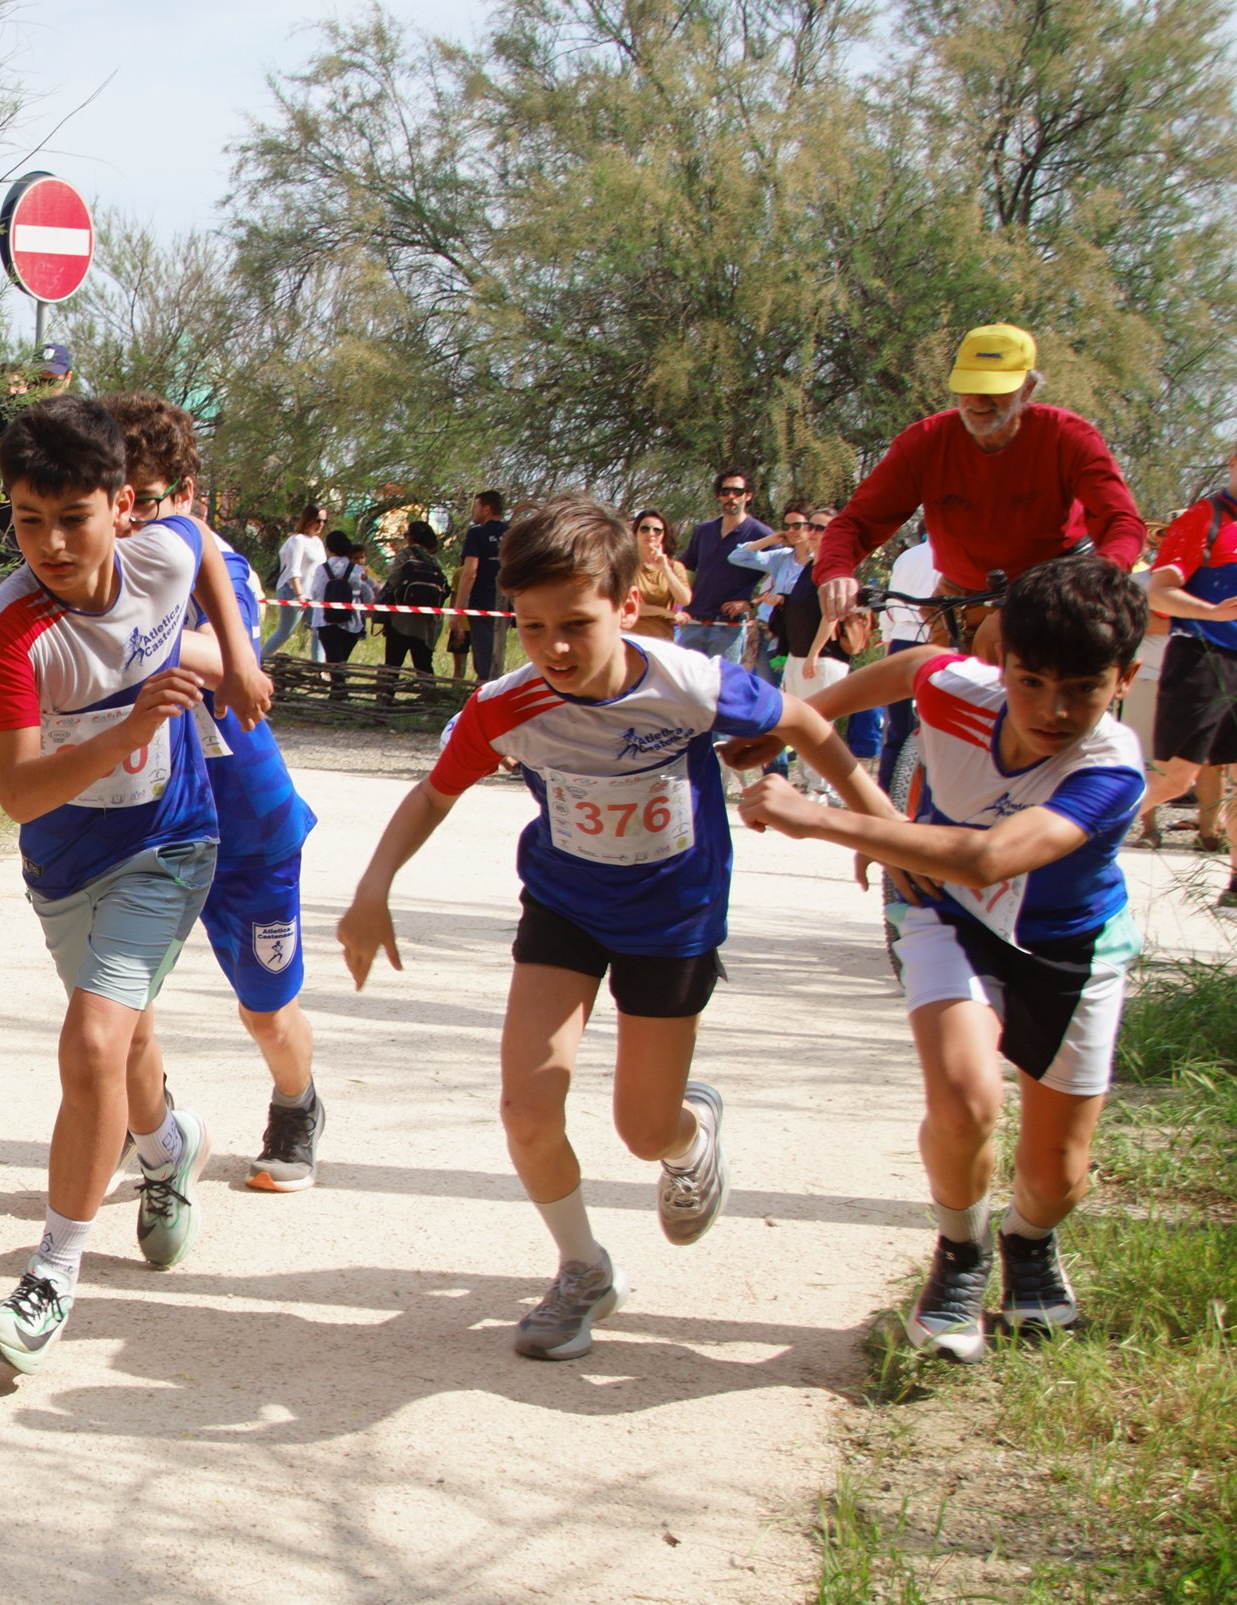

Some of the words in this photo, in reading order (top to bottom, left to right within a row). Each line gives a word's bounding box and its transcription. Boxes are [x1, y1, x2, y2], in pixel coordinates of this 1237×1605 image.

[143, 604, 180, 646] Atletica
[144, 606, 183, 657] Castena
[574, 795, 671, 838] 376
